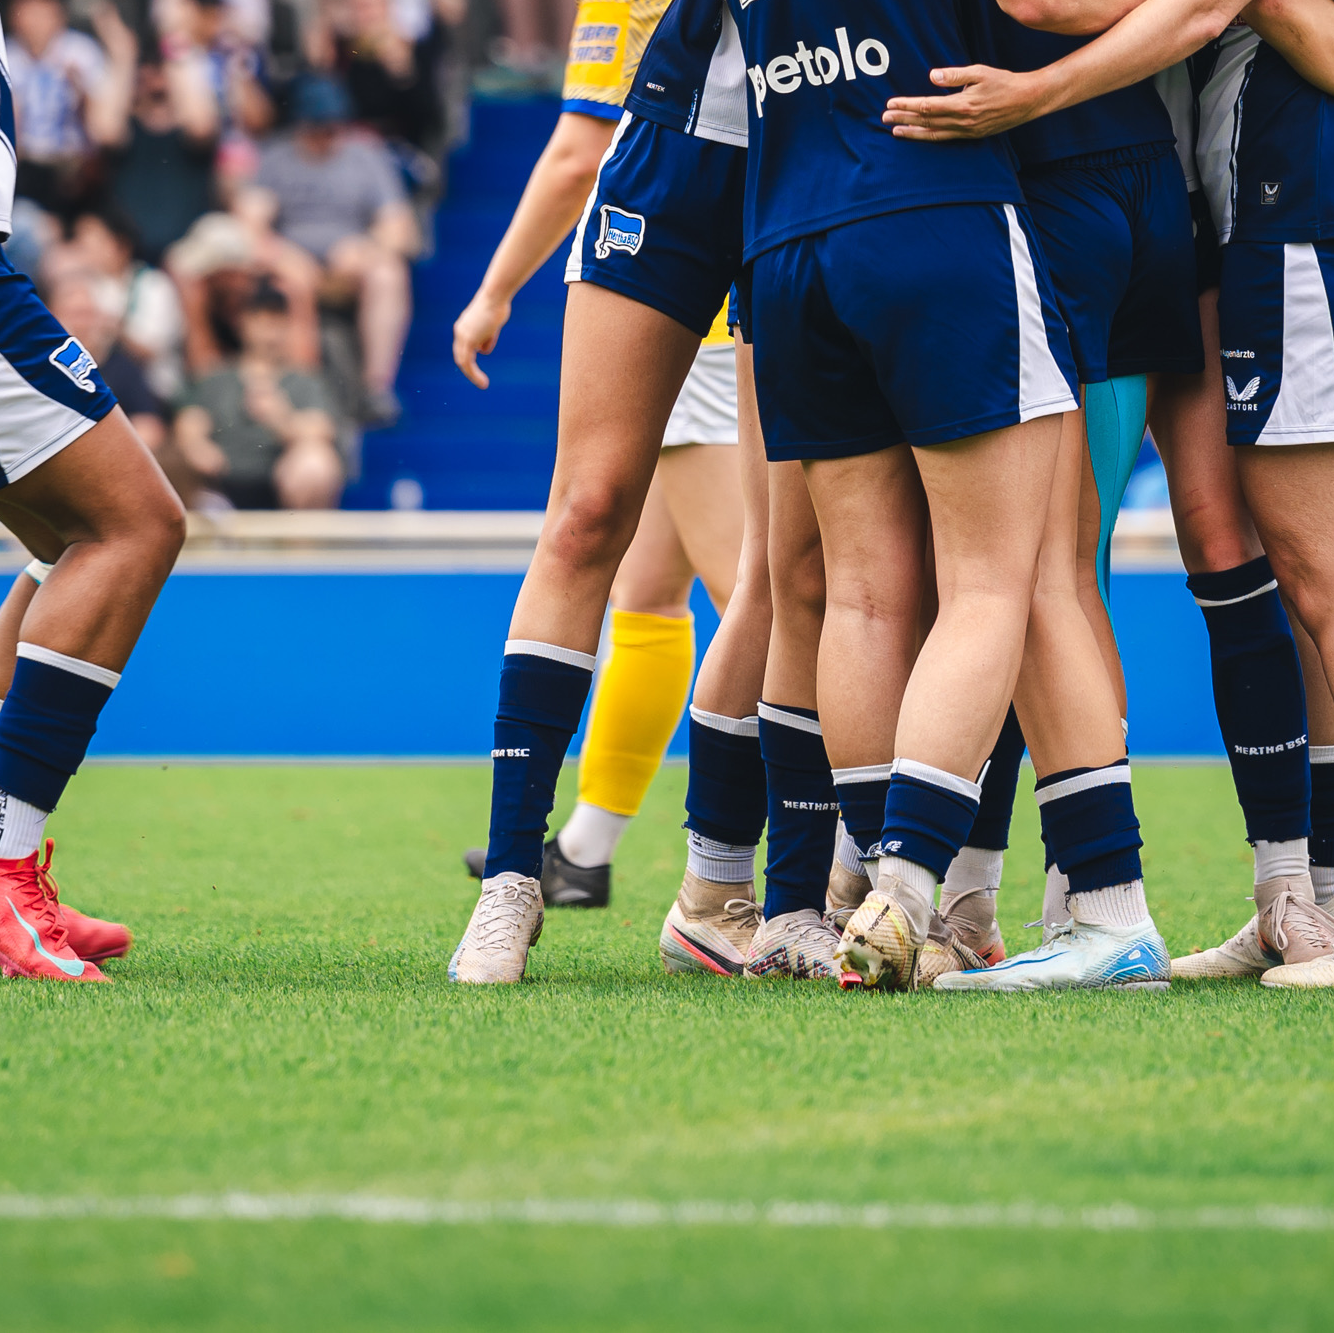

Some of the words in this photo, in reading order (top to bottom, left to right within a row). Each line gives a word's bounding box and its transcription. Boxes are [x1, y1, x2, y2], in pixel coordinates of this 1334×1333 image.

[747, 27, 890, 118] petolo
[506, 748, 530, 758] BSC
[1234, 744, 1284, 756] HERTHA
[1285, 734, 1307, 750] BSC
[782, 799, 828, 811] HERTHA
[829, 802, 841, 811] BS
